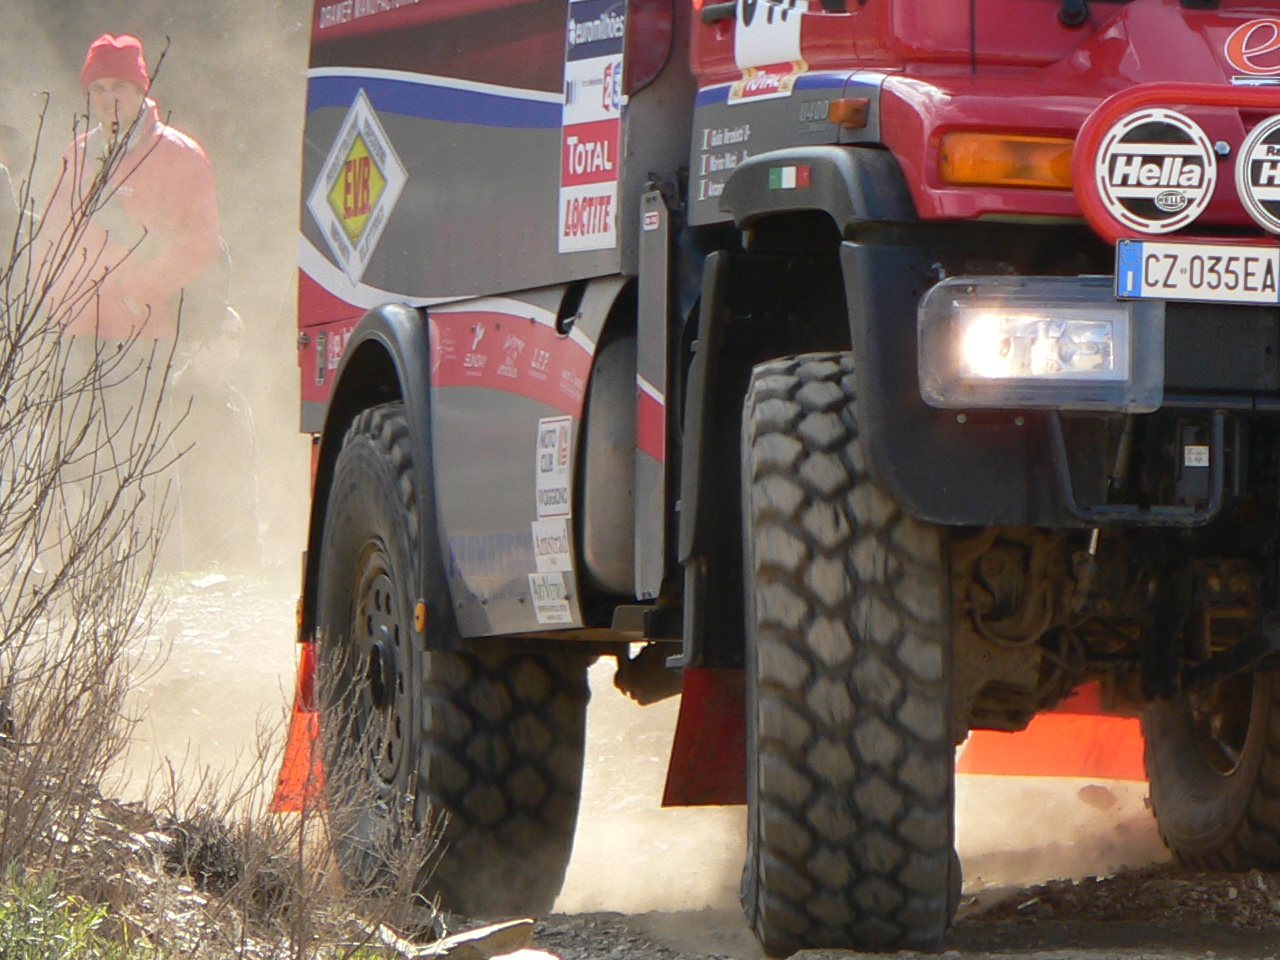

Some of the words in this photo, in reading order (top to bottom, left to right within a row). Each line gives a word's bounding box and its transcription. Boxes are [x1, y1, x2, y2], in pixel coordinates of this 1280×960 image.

[567, 136, 613, 175] TOTAL
[1112, 155, 1203, 187] Hella
[563, 194, 612, 238] LOCTITE
